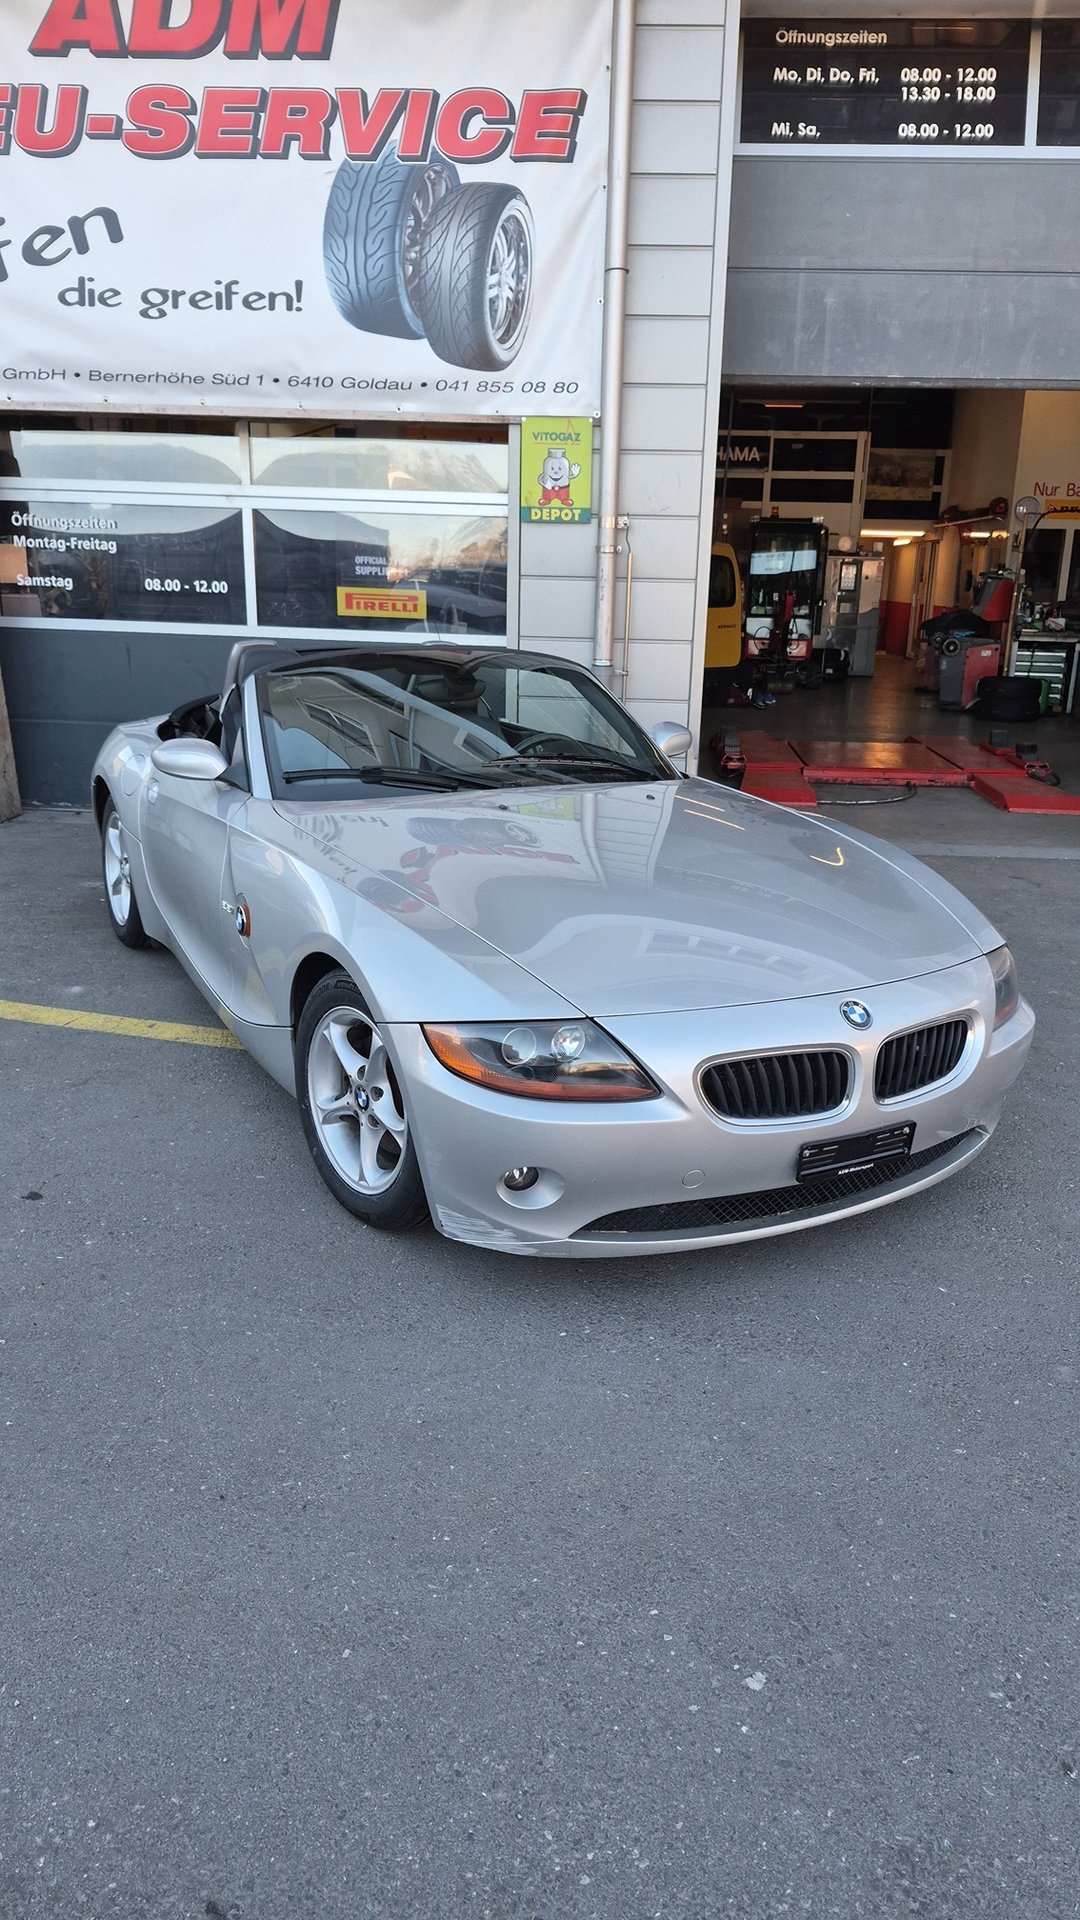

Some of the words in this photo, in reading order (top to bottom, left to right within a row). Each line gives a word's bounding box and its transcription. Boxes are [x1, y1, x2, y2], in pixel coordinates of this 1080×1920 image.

[28, 0, 340, 60] ADM
[775, 26, 888, 46] Öffnungszeiten
[773, 67, 802, 83] Mo,
[806, 67, 825, 83] Di,
[829, 67, 855, 83] Do,
[858, 67, 880, 83] Fri,
[900, 67, 942, 82] 08.00
[957, 67, 997, 82] 12.00
[901, 86, 941, 101] 13.30
[956, 86, 996, 101] 18.00
[0, 83, 588, 163] U-SERVICE
[771, 122, 794, 137] Mi,
[797, 122, 821, 137] Sa,
[898, 123, 939, 137] 08.00
[954, 123, 994, 137] 12.00
[57, 276, 122, 307] die
[139, 279, 303, 319] greifen!
[2, 367, 66, 381] GmbH
[88, 369, 205, 385] Bernerhöhe
[211, 372, 250, 386] Süd
[255, 373, 265, 386] 1
[287, 375, 334, 388] 6410
[341, 376, 412, 391] Goldau
[436, 379, 469, 392] 041
[476, 380, 514, 393] 855
[521, 381, 546, 394] 08
[552, 381, 579, 394] 80
[1033, 482, 1061, 497] Nur
[11, 510, 118, 531] Öffnungszeiten
[530, 508, 581, 521] DEPOT
[13, 535, 117, 554] Montag-Freitag
[355, 556, 387, 565] OFFICIAL
[16, 573, 73, 591] Samstag
[144, 578, 181, 592] 08.00
[193, 580, 228, 594] 12.00
[344, 592, 419, 613] PIRELLI
